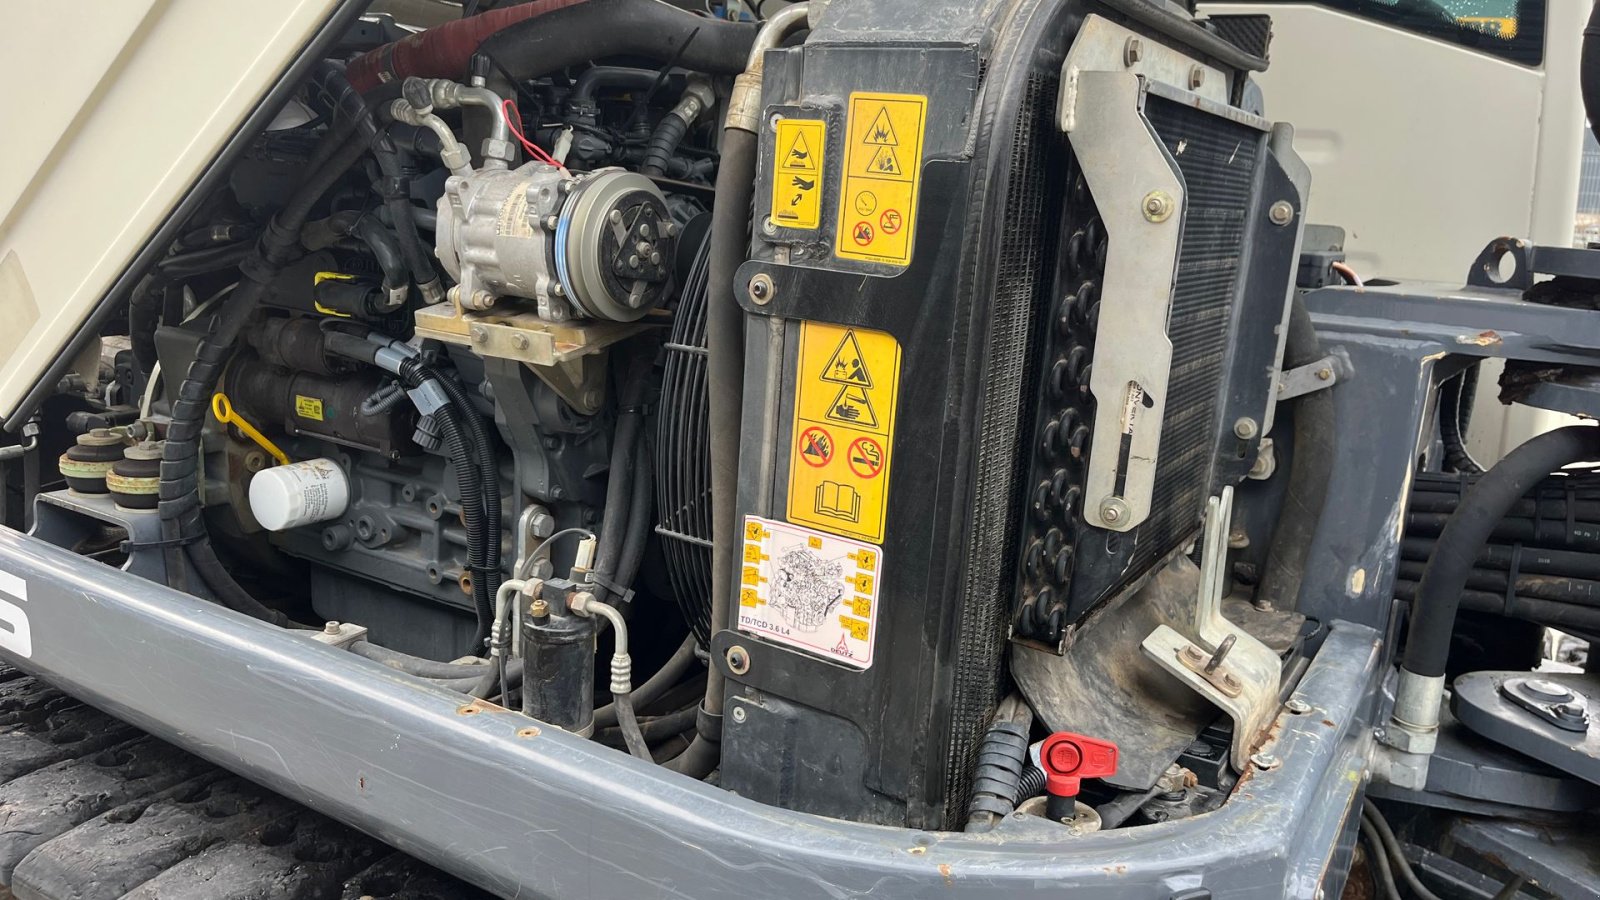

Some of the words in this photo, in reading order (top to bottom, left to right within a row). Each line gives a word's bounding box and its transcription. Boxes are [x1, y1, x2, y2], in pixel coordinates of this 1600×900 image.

[740, 616, 768, 628] TD/TCD
[769, 624, 780, 632] 3.6
[781, 627, 790, 635] L4
[830, 647, 853, 657] DEUTZ
